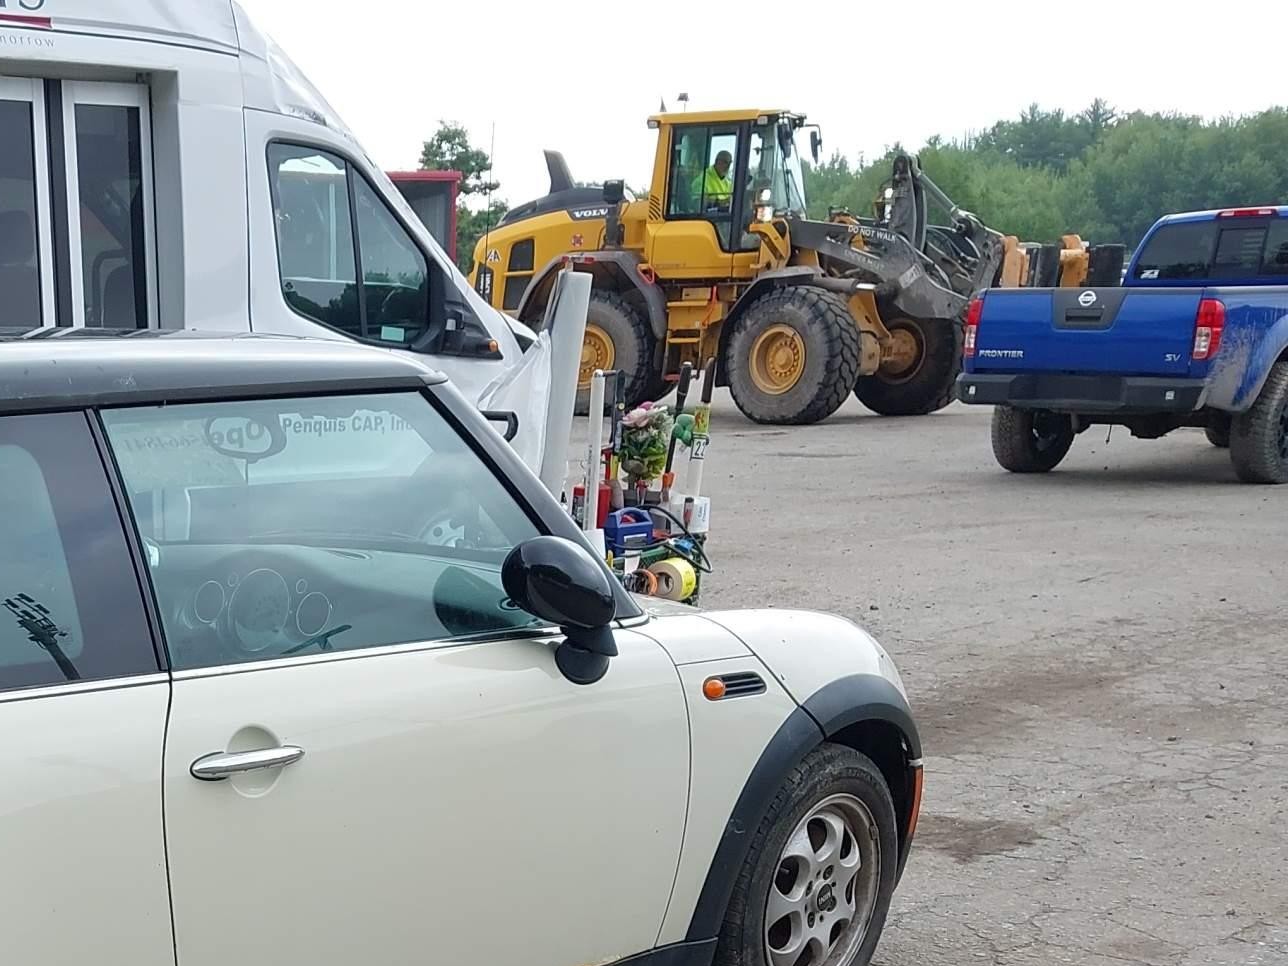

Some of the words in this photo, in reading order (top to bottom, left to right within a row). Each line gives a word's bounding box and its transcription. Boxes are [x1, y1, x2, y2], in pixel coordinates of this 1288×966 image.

[573, 208, 608, 218] VOLV
[847, 224, 859, 234] DO
[860, 228, 876, 238] NOT
[876, 230, 896, 242] WALK
[979, 350, 1024, 359] FRONTIER
[1164, 353, 1182, 363] SV
[282, 417, 346, 437] Penquis
